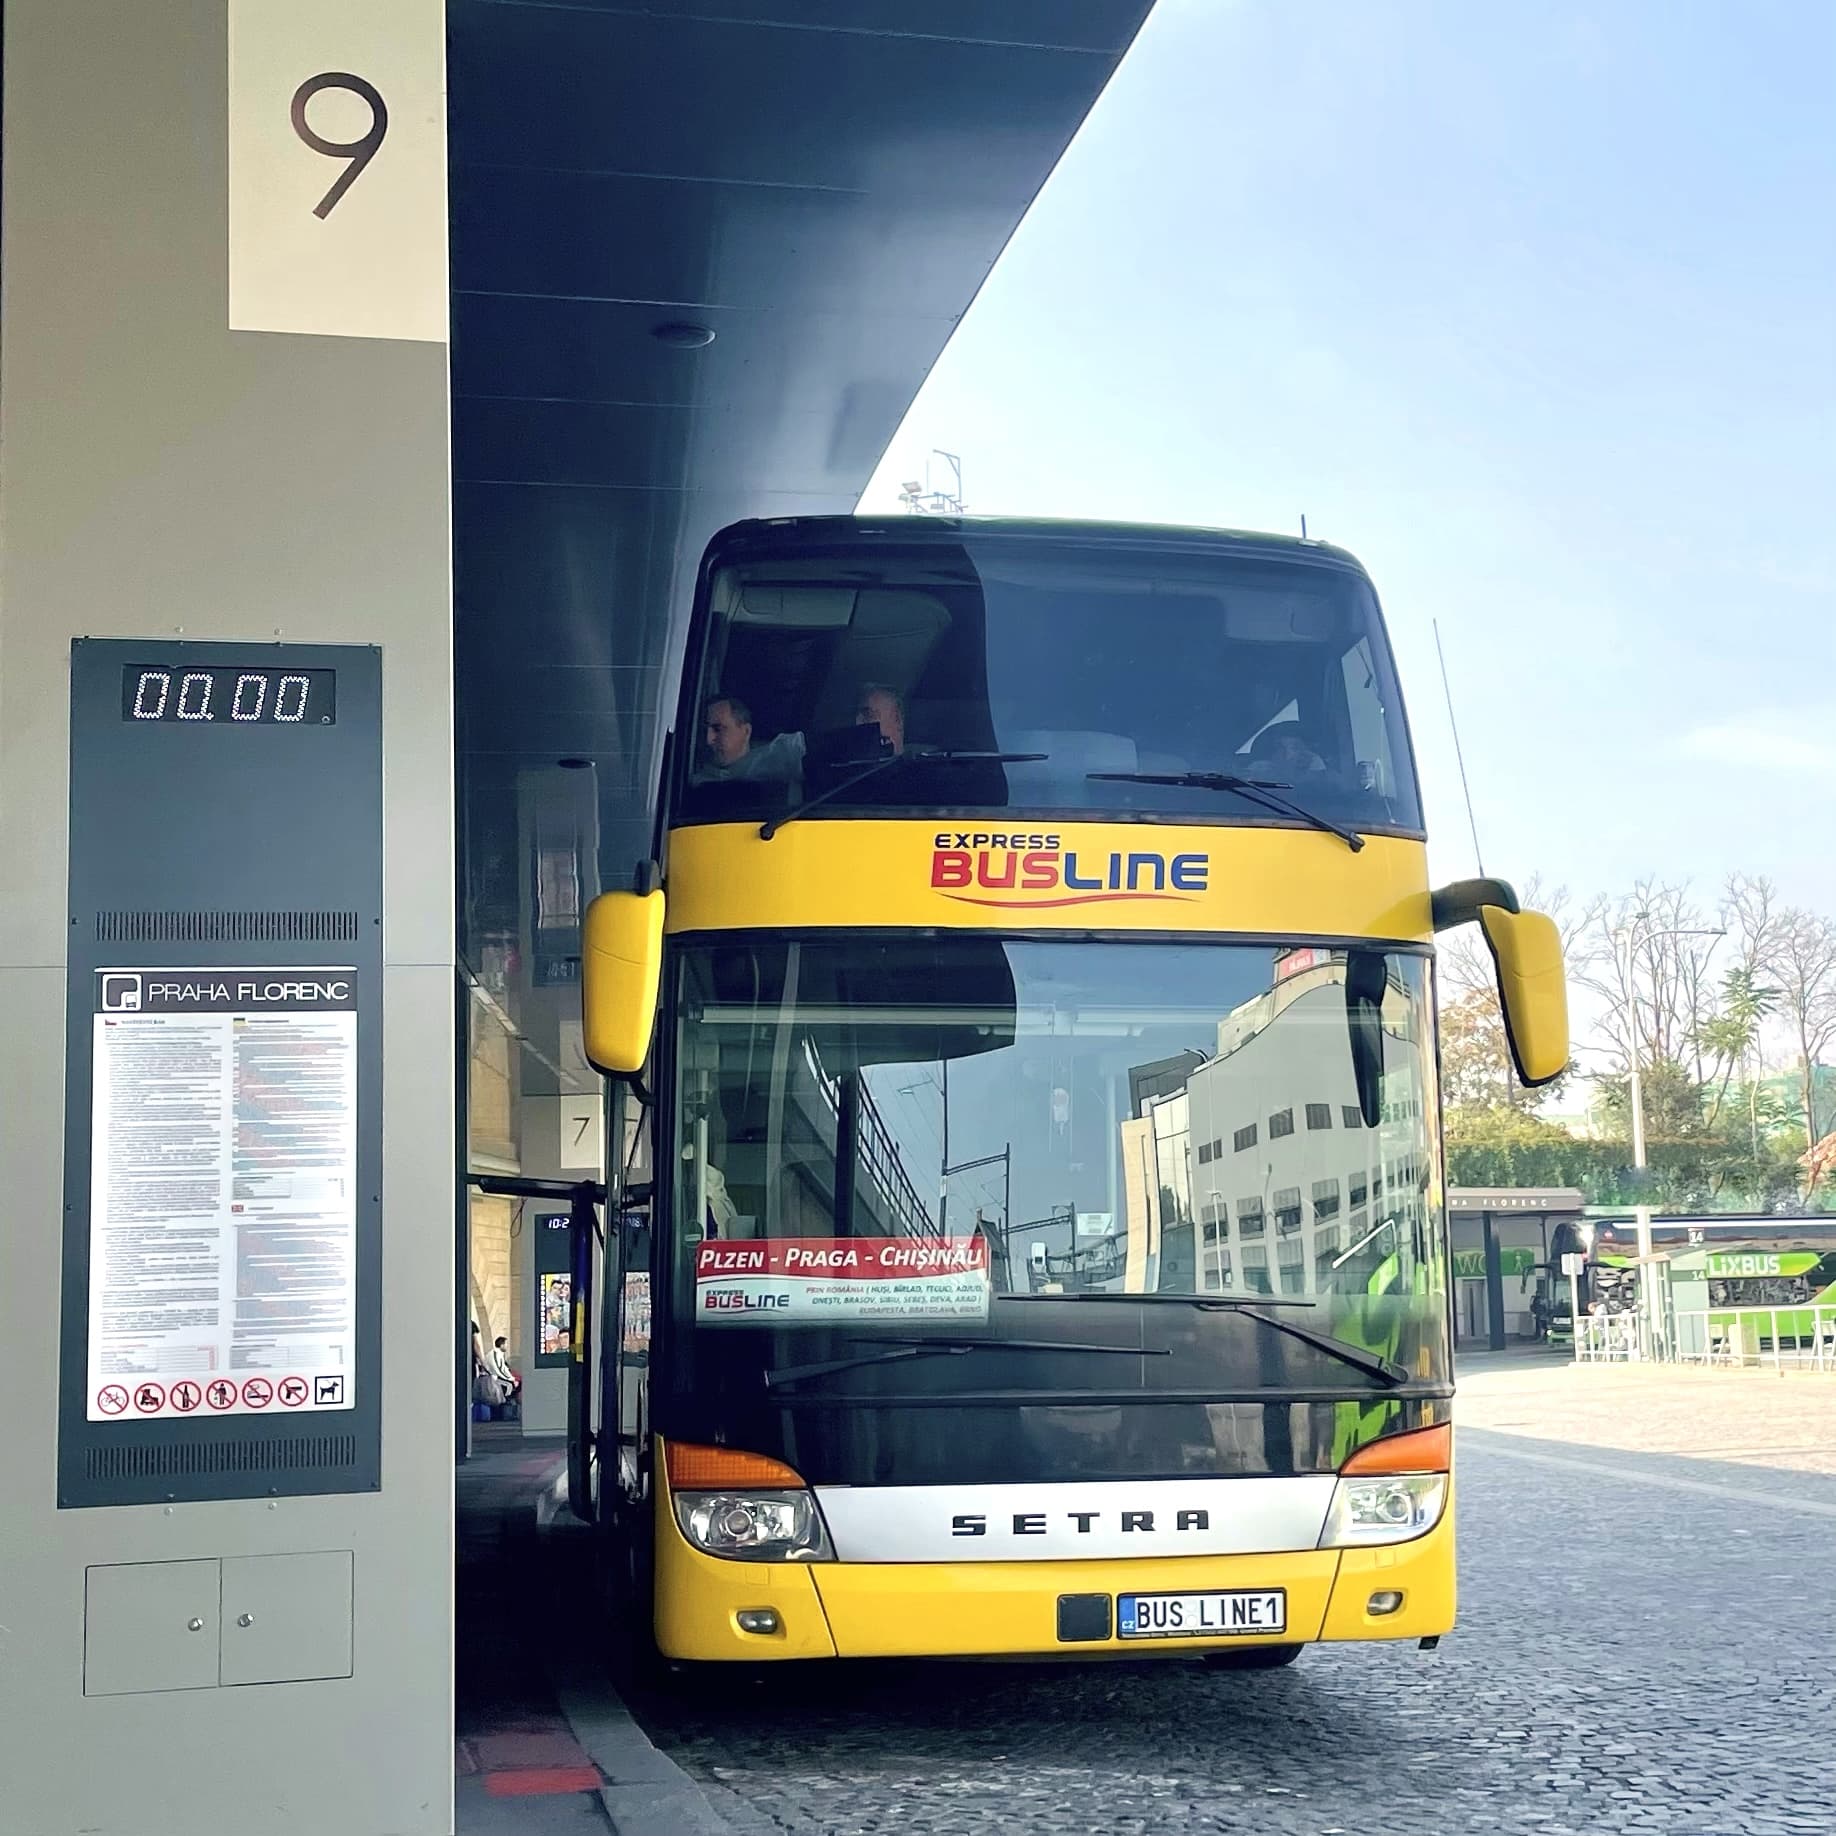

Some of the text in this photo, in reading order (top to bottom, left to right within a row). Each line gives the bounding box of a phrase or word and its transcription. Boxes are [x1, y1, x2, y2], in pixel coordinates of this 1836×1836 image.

[290, 71, 388, 220] 9
[934, 833, 1061, 849] EXPRESS
[930, 850, 1209, 890] BUSLINE
[148, 981, 350, 1002] PRAHA FLORENC
[572, 1117, 591, 1147] 7
[699, 1249, 764, 1269] PLZEN
[784, 1247, 859, 1267] PRAGA
[705, 1294, 790, 1308] BUSLINE
[952, 1508, 1209, 1537] SETRA
[1121, 1597, 1278, 1630] CZ BUS LINE1
